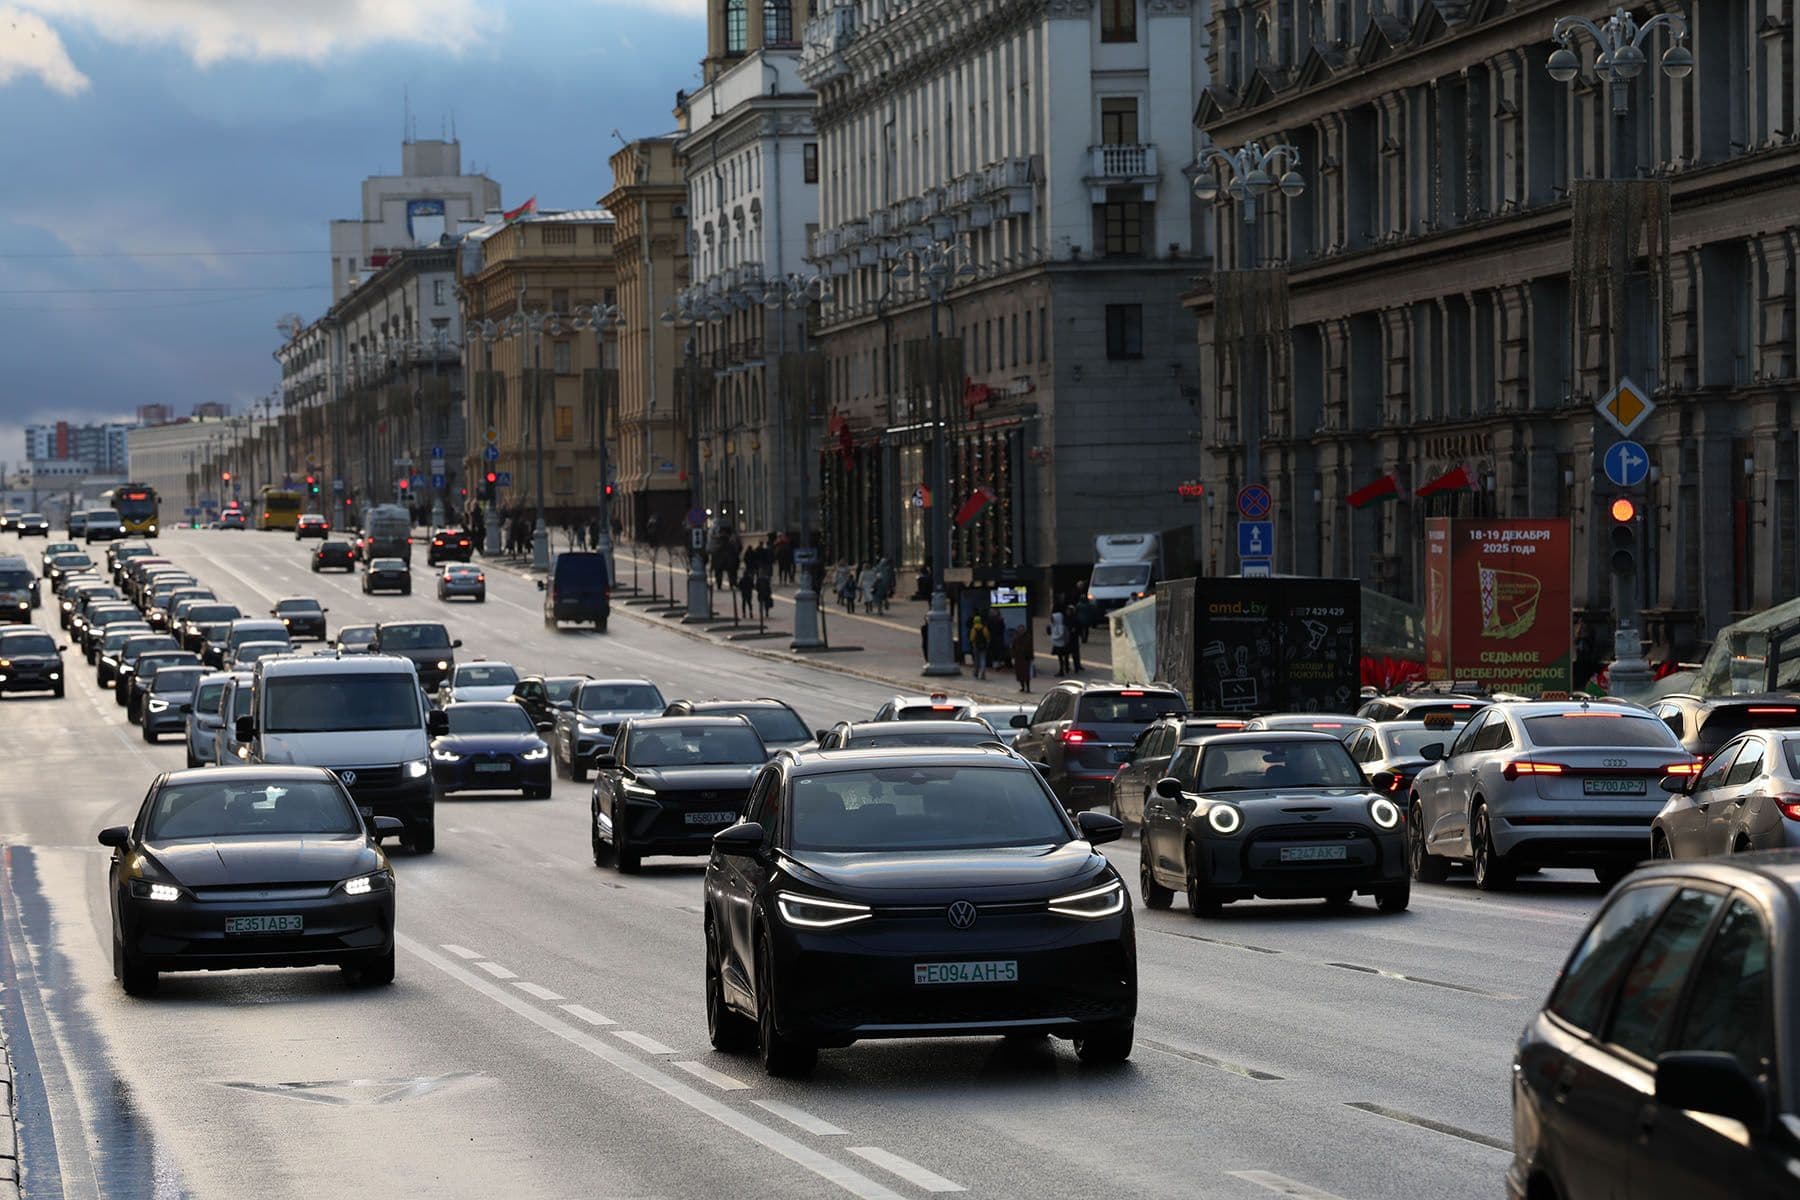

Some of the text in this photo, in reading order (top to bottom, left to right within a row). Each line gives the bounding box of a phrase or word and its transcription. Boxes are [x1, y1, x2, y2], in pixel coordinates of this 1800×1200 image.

[1470, 530, 1550, 541] 18-19 ДЕКАБРЯ
[1483, 544, 1536, 555] 2025 года
[1312, 608, 1328, 616] 429
[1329, 608, 1345, 616] 429
[1480, 652, 1540, 663] СЕДЬМОЕ
[1455, 668, 1565, 679] ВСЕБЕЛОРУССКОЕ
[1484, 683, 1544, 695] АРОДНОЕ
